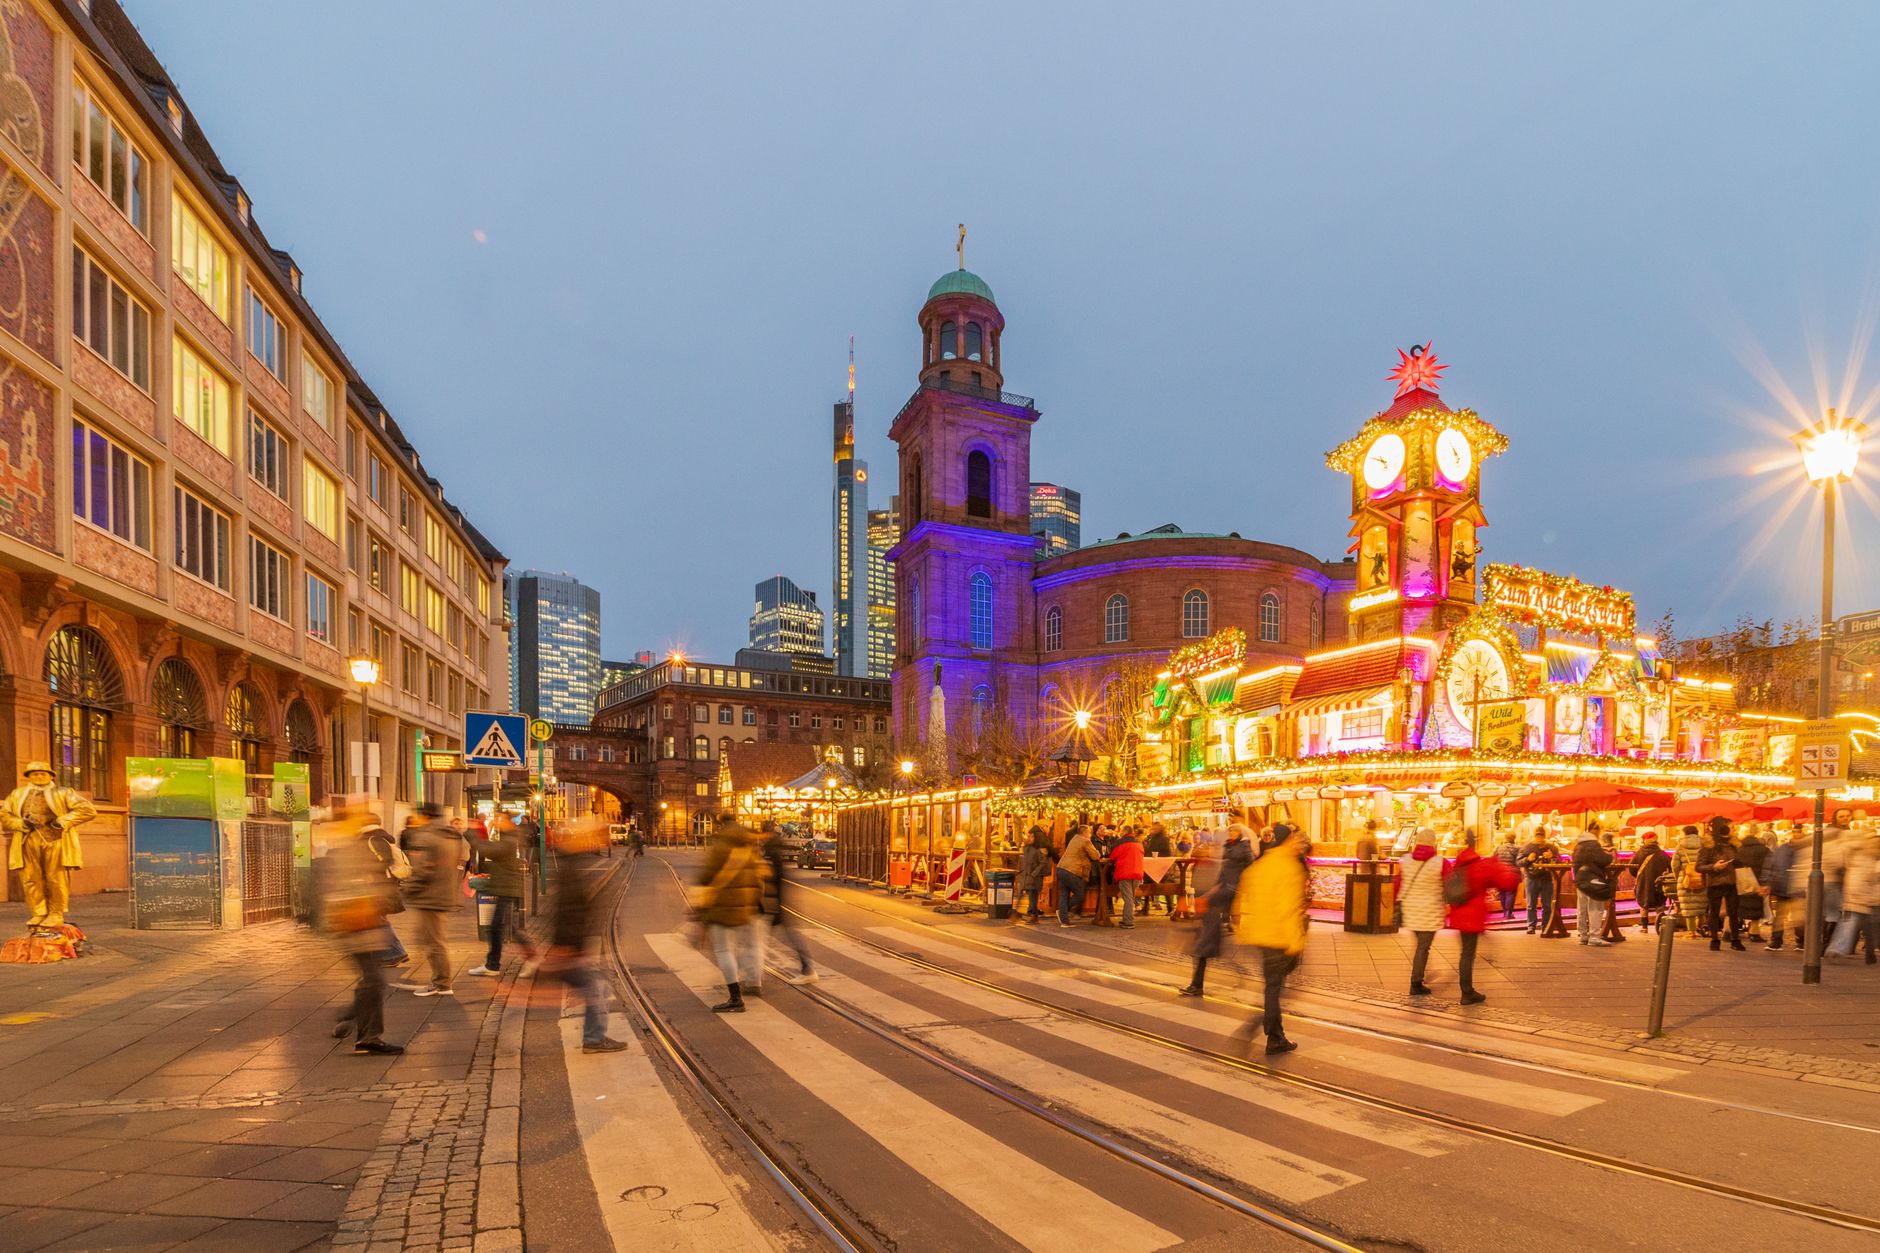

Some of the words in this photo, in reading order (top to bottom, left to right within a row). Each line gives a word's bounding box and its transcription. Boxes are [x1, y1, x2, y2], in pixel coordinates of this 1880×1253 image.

[1494, 578, 1529, 606] Zum
[1851, 616, 1880, 633] Brau
[1490, 707, 1513, 719] Wild
[1487, 714, 1523, 731] Bratwurst
[535, 724, 546, 736] H
[1729, 741, 1755, 752] Braten
